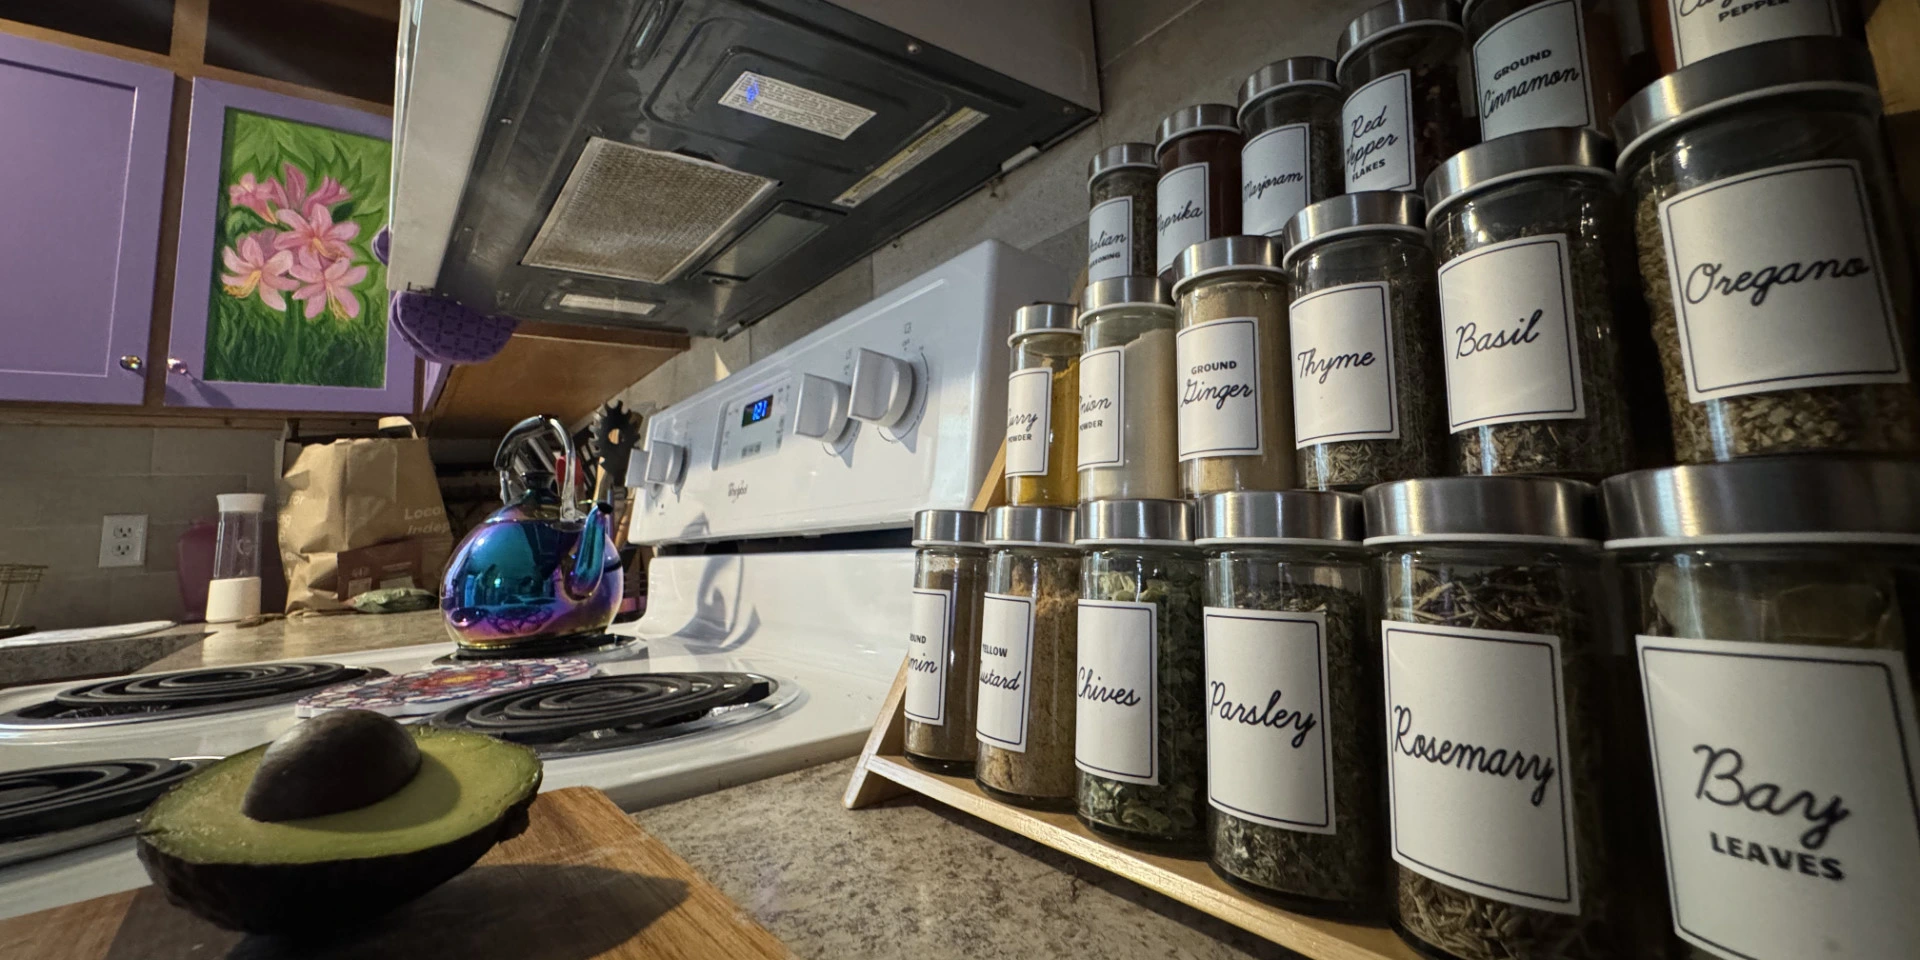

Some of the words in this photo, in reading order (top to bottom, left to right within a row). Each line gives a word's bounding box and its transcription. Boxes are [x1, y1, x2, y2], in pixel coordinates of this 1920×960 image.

[1493, 49, 1552, 81] GROUND
[1482, 65, 1580, 119] Cinnamon
[1351, 105, 1387, 139] Red
[1351, 158, 1386, 182] FLAKES
[1089, 230, 1127, 253] talian
[1685, 256, 1870, 306] Oregano
[1455, 309, 1544, 360] Basil
[1191, 360, 1237, 375] GROUND
[1297, 348, 1376, 384] Thyme
[1079, 395, 1112, 414] nion
[1180, 378, 1254, 410] Ginger
[1008, 408, 1038, 432] urry
[908, 653, 938, 673] min
[980, 660, 1022, 691] ustard
[1078, 666, 1141, 706] Chives
[1210, 680, 1317, 749] Parsley
[1393, 704, 1555, 808] Rosemary
[1692, 744, 1851, 850] Bay
[1709, 831, 1847, 882] LEAVES
